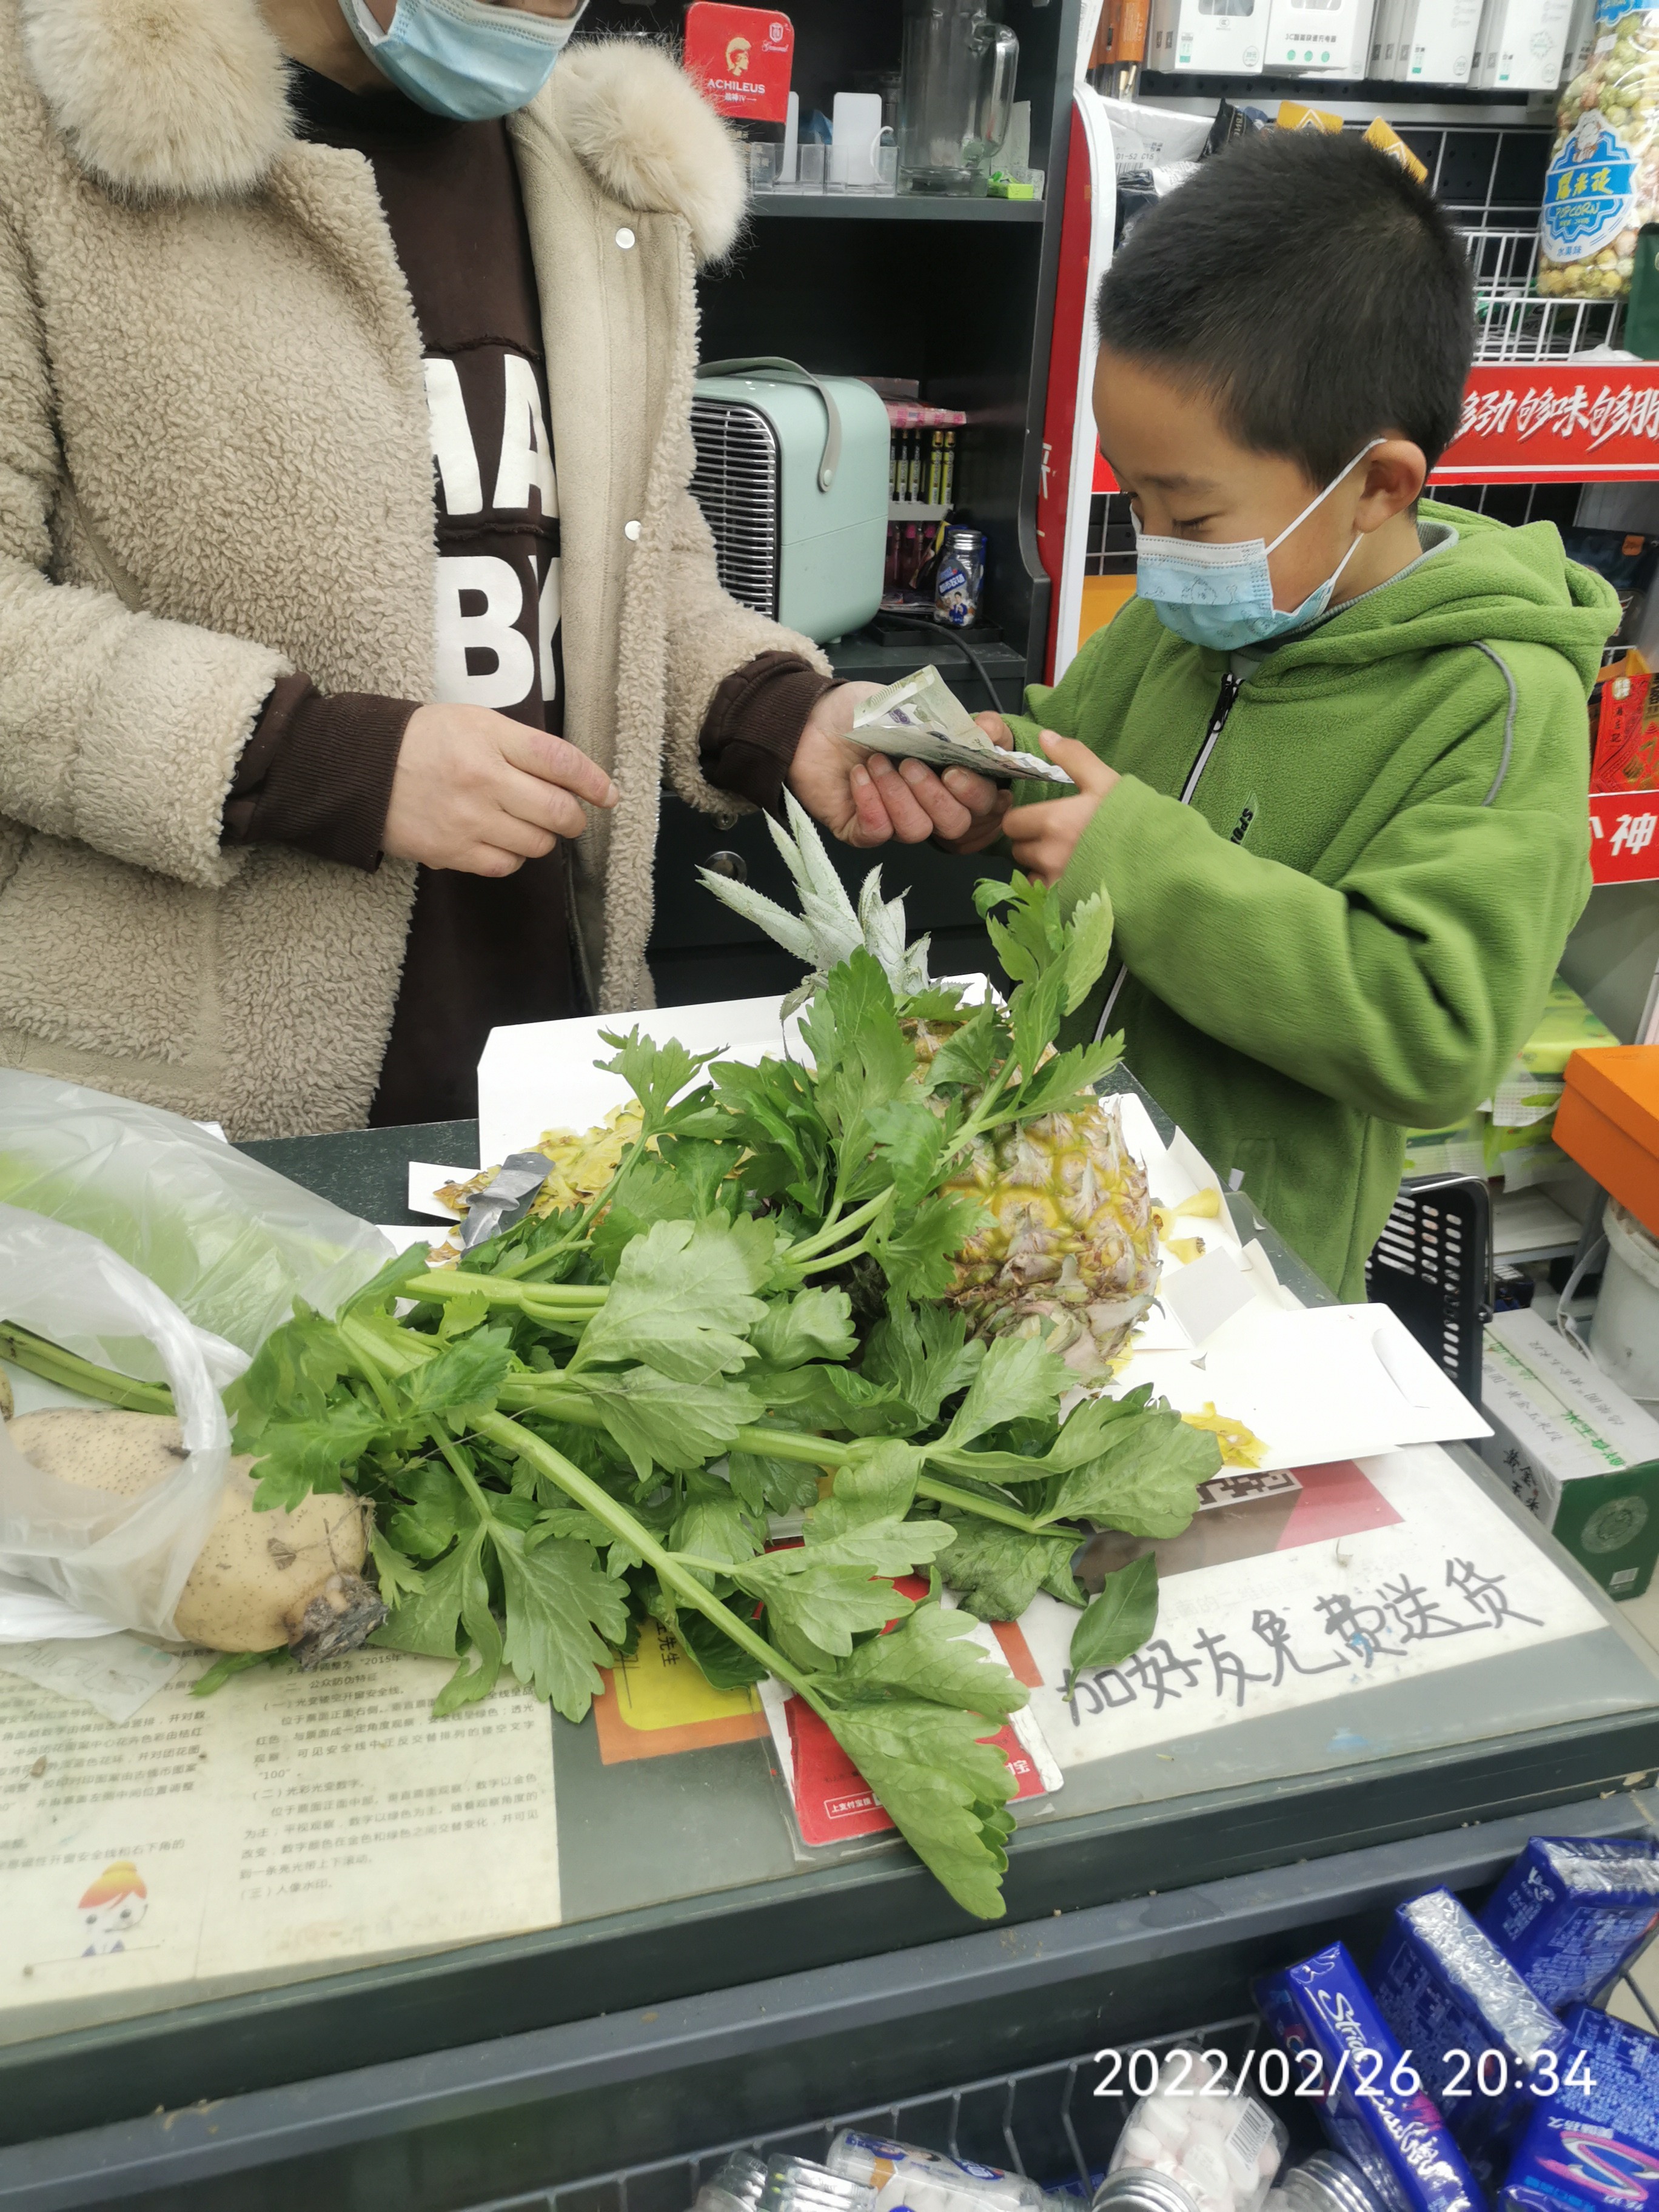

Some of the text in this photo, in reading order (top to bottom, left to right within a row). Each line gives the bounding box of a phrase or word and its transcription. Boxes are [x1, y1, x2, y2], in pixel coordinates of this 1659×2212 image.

[707, 78, 766, 94] ACHILEUS
[1557, 245, 1582, 257] 水果味
[1056, 1556, 1546, 1727] 加好友免费送货
